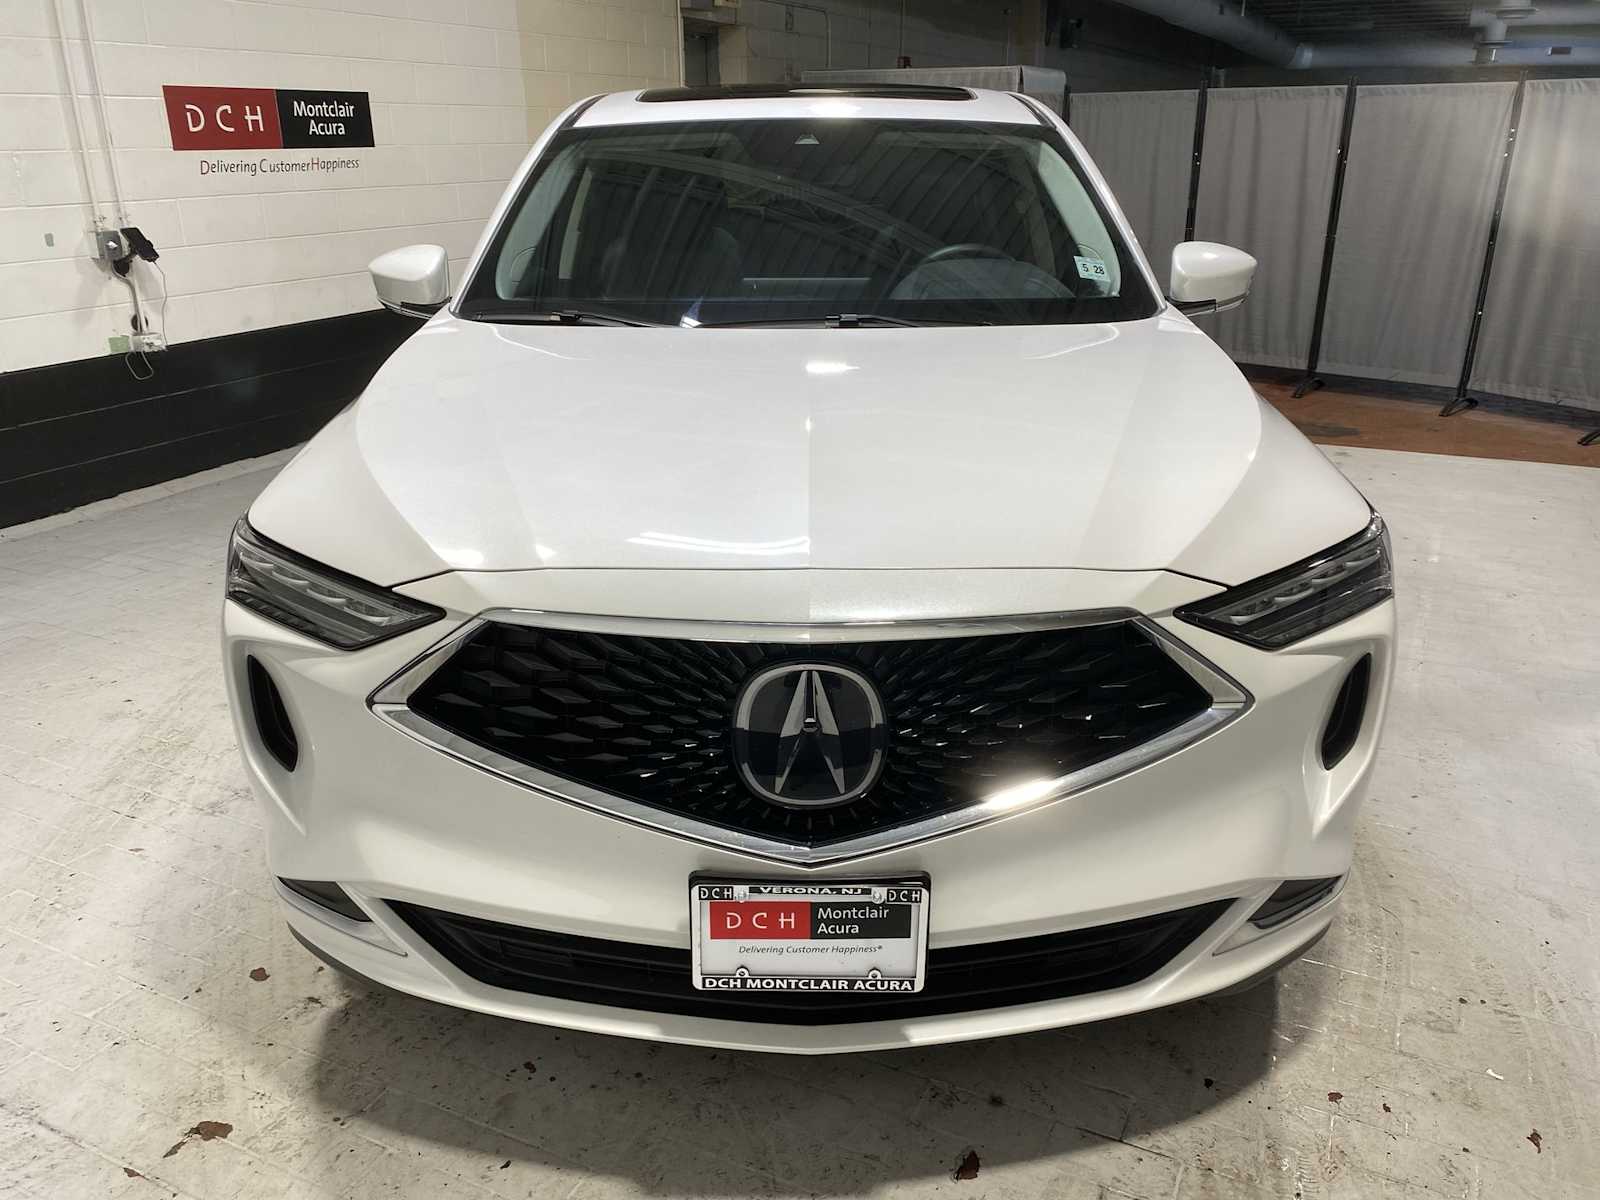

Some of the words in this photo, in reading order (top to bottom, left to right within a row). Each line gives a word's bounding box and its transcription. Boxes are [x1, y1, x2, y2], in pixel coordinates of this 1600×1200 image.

[293, 100, 355, 118] Montclair
[185, 103, 264, 132] DCH
[309, 119, 346, 136] Acura
[200, 160, 257, 176] Delivering
[1082, 263, 1089, 273] 5
[1093, 264, 1105, 275] 28
[700, 887, 732, 899] DCH
[841, 887, 862, 895] NJ
[888, 889, 921, 902] DCH
[817, 906, 889, 919] Montclair
[726, 912, 795, 929] DCH
[817, 922, 859, 935] Acura
[739, 945, 784, 955] Delivering
[786, 945, 829, 954] Customer
[705, 978, 741, 989] DCH
[746, 978, 849, 990] MONTCLAIR
[853, 980, 912, 991] ACURA
